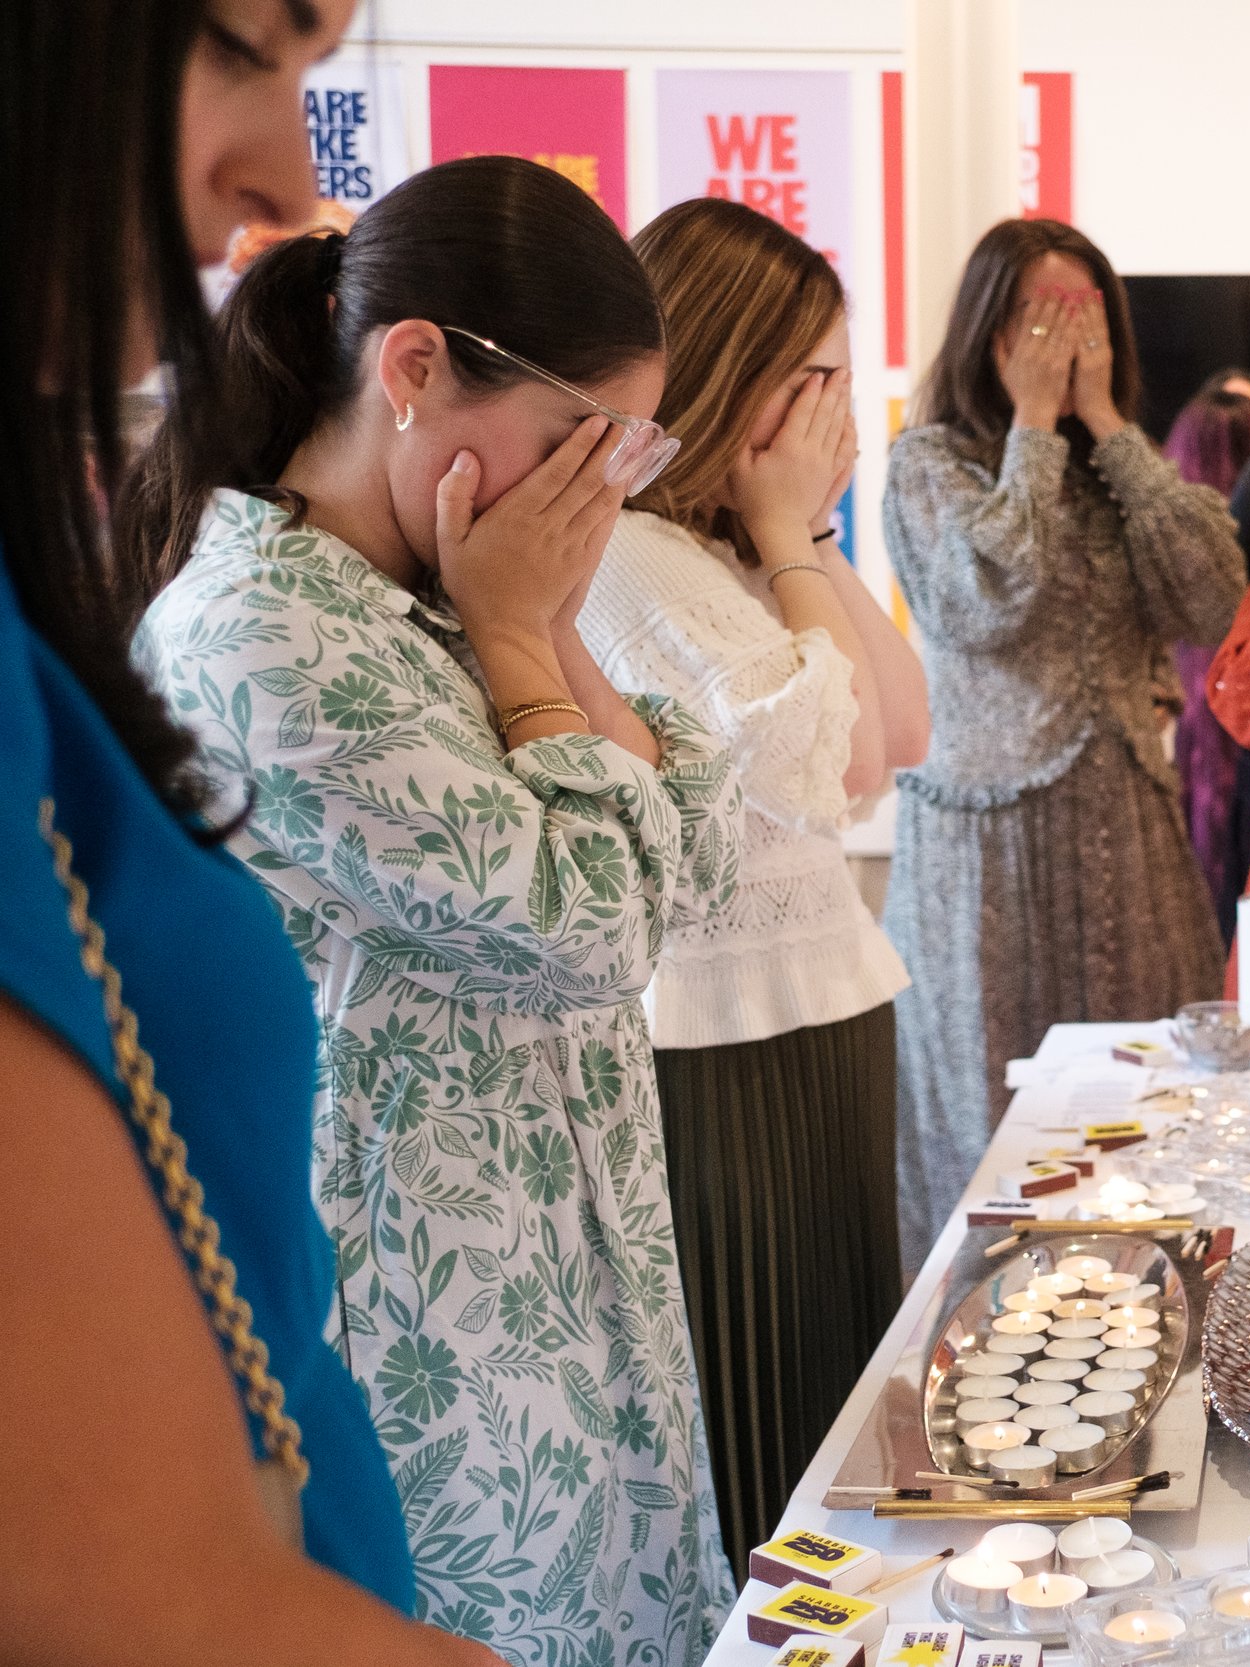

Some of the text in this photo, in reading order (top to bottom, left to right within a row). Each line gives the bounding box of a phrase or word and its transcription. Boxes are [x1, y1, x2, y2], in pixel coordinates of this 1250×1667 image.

[303, 90, 368, 124] ARE
[309, 128, 357, 161] KE
[706, 113, 799, 173] WE
[782, 1536, 846, 1561] 250
[802, 1532, 854, 1553] SHABBAT
[779, 1599, 850, 1626] 250
[798, 1595, 857, 1615] SHABBAT
[919, 1632, 934, 1643] THE
[809, 1650, 831, 1667] SHA
[975, 1653, 992, 1667] LIGH
